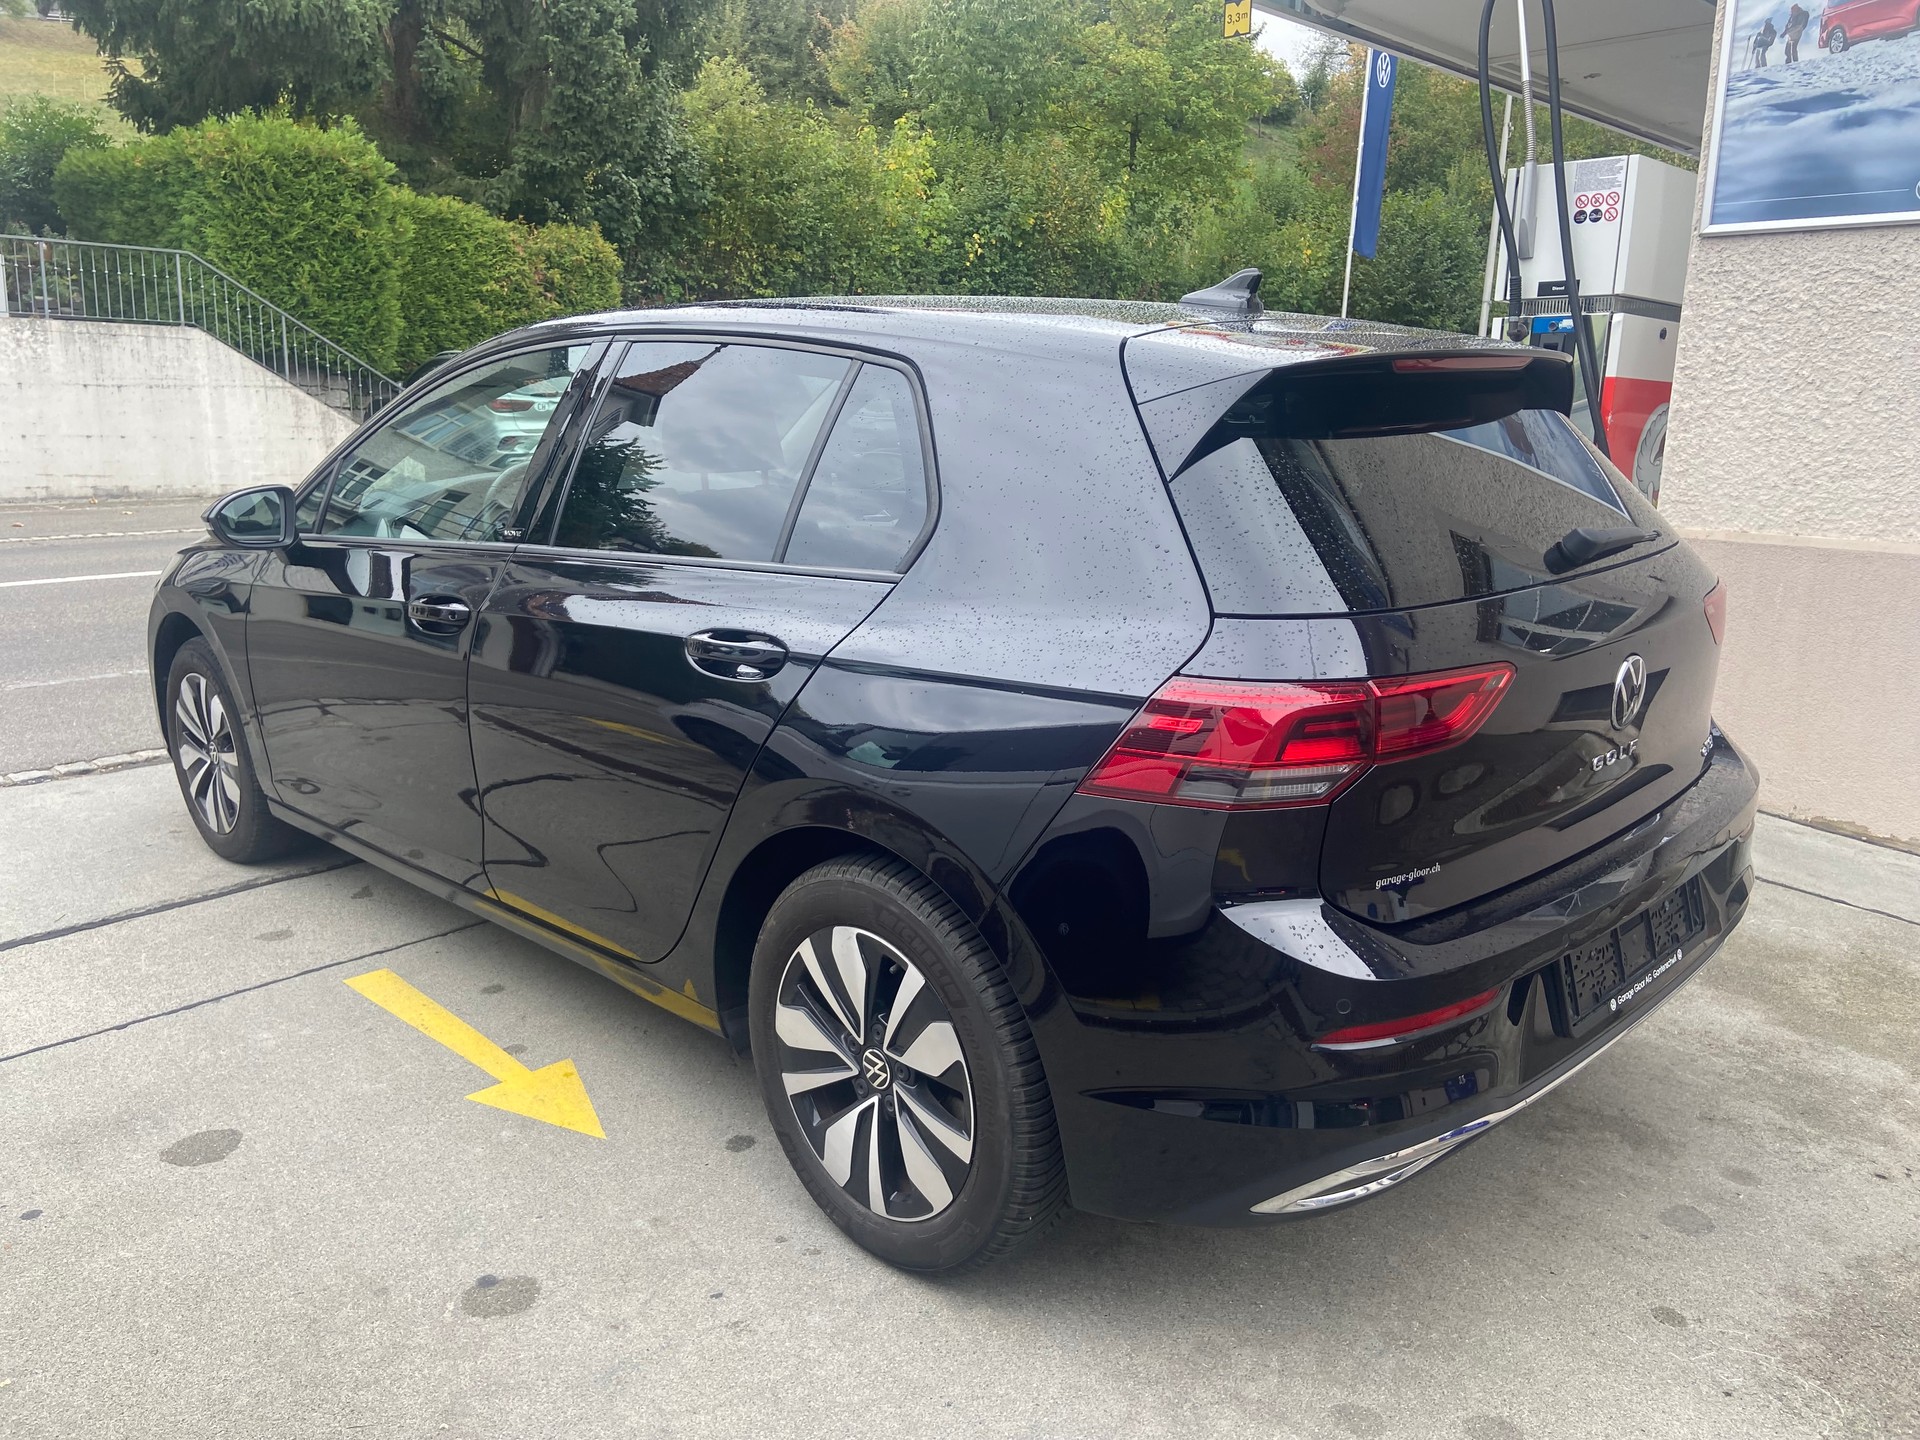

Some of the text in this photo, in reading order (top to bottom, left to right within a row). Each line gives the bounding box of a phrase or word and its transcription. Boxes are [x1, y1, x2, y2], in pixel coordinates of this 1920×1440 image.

[1591, 738, 1639, 772] GOLF
[1375, 862, 1441, 890] garage-gloor.ch
[877, 908, 963, 1004] MICHELIN
[1618, 989, 1634, 1004] Garage
[1645, 973, 1652, 984] AG
